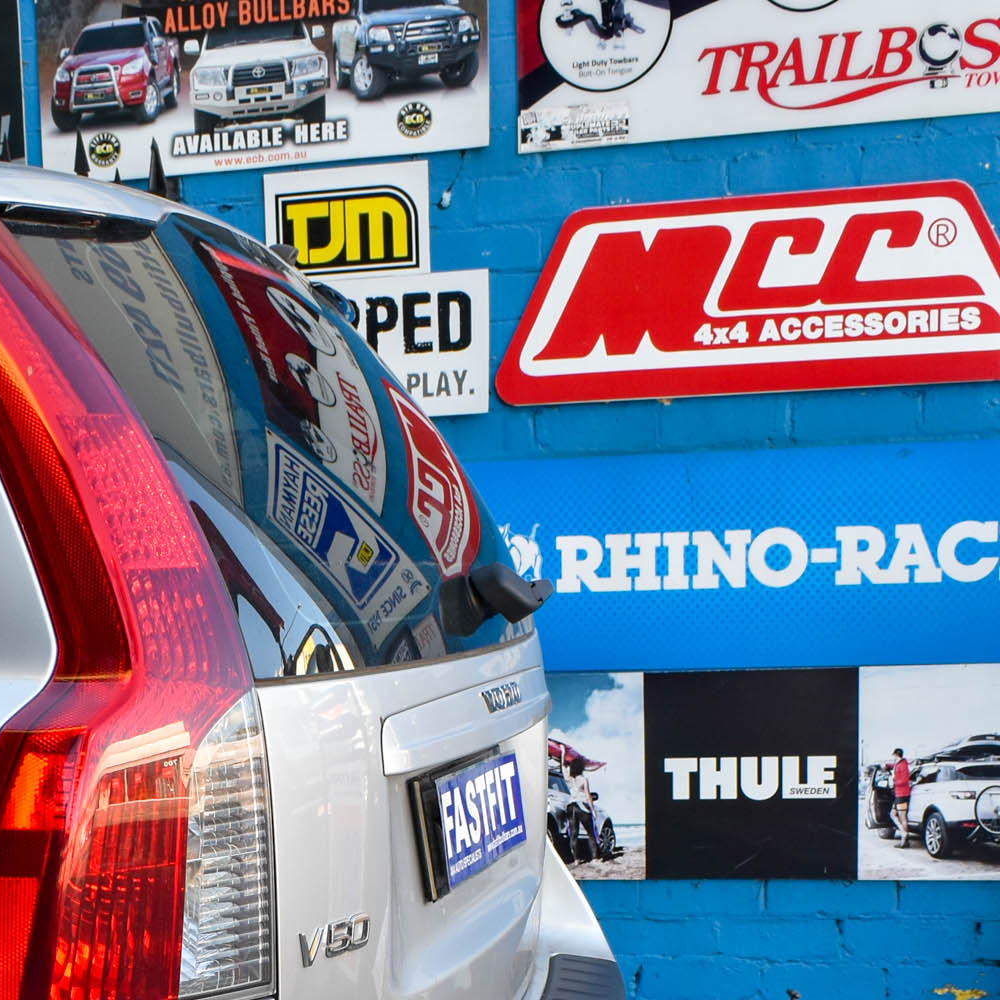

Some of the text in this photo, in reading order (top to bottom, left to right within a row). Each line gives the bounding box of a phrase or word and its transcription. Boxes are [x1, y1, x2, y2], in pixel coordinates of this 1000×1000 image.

[164, 0, 350, 33] ALLOY BULLBARS
[172, 119, 348, 156] AVAILABLE HERE
[214, 151, 307, 167] www.ecb.com.au
[286, 196, 409, 265] TJM
[694, 307, 982, 346] 4x4 ACCESSORIES
[406, 369, 475, 397] PLAY.
[556, 519, 1000, 594] RHINO-RAC
[663, 755, 838, 801] THULE
[789, 786, 830, 796] SWEDEN
[441, 761, 516, 860] FASTFIT
[299, 911, 371, 968] V50
